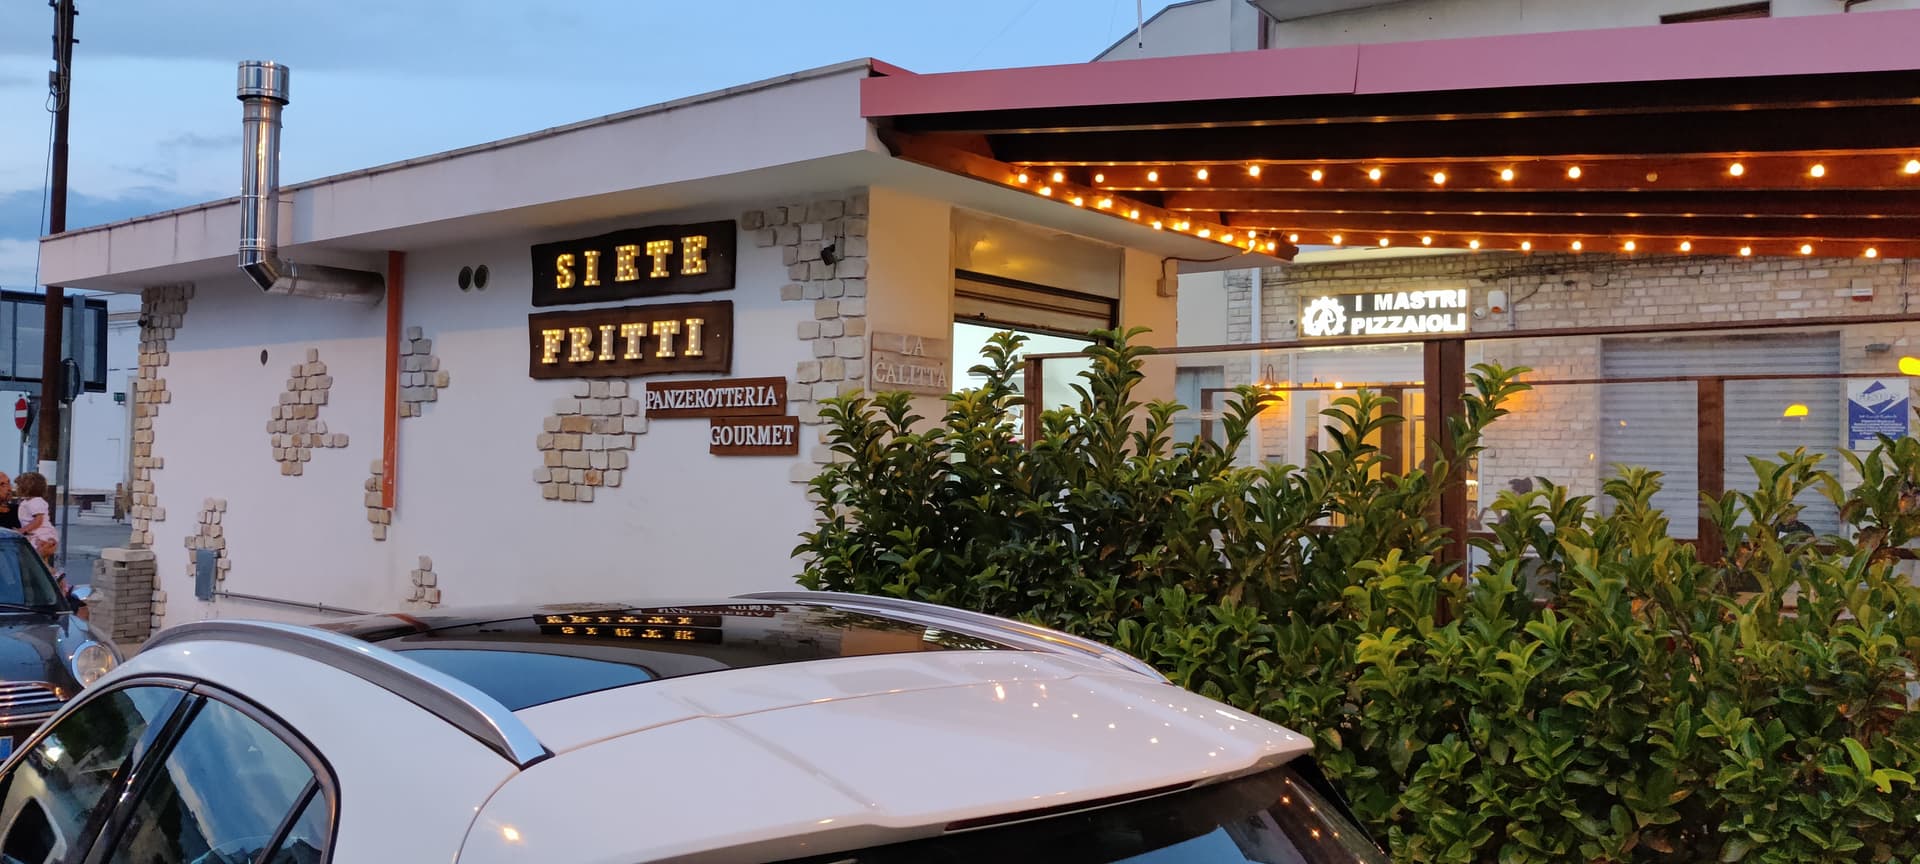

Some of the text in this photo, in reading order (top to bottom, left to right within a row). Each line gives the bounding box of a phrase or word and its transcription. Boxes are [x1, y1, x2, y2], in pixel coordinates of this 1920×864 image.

[556, 235, 708, 289] SIETE
[1355, 289, 1467, 312] I MASTRI
[1350, 313, 1466, 335] PIZZAIOLI
[541, 317, 705, 364] FRITTI
[902, 335, 925, 356] LA
[646, 386, 778, 411] PANZEROTTERIA
[710, 424, 795, 446] GOURMET
